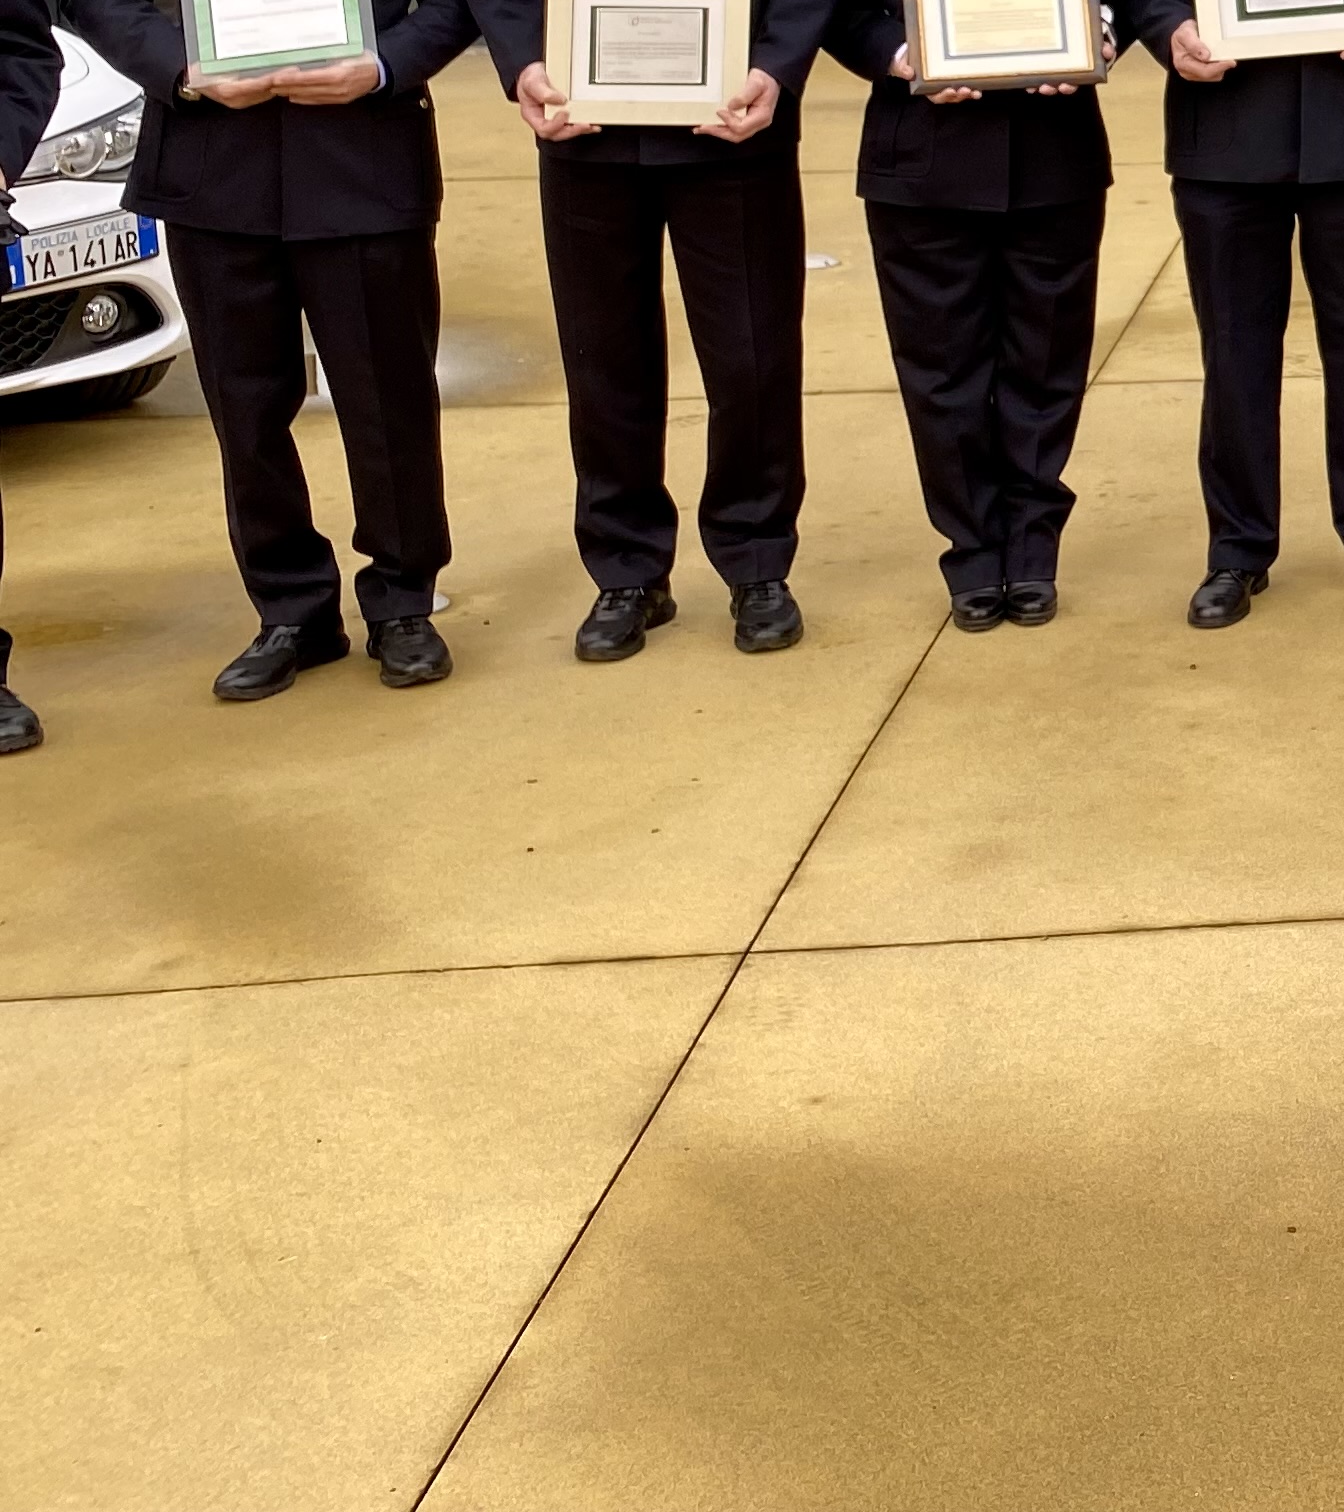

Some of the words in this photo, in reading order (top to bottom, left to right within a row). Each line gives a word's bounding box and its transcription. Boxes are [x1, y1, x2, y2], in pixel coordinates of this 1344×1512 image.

[32, 232, 78, 250] POLIZIA
[86, 218, 131, 237] LOCALE
[26, 251, 56, 281] YA
[69, 239, 106, 272] 141
[114, 231, 139, 262] AR
